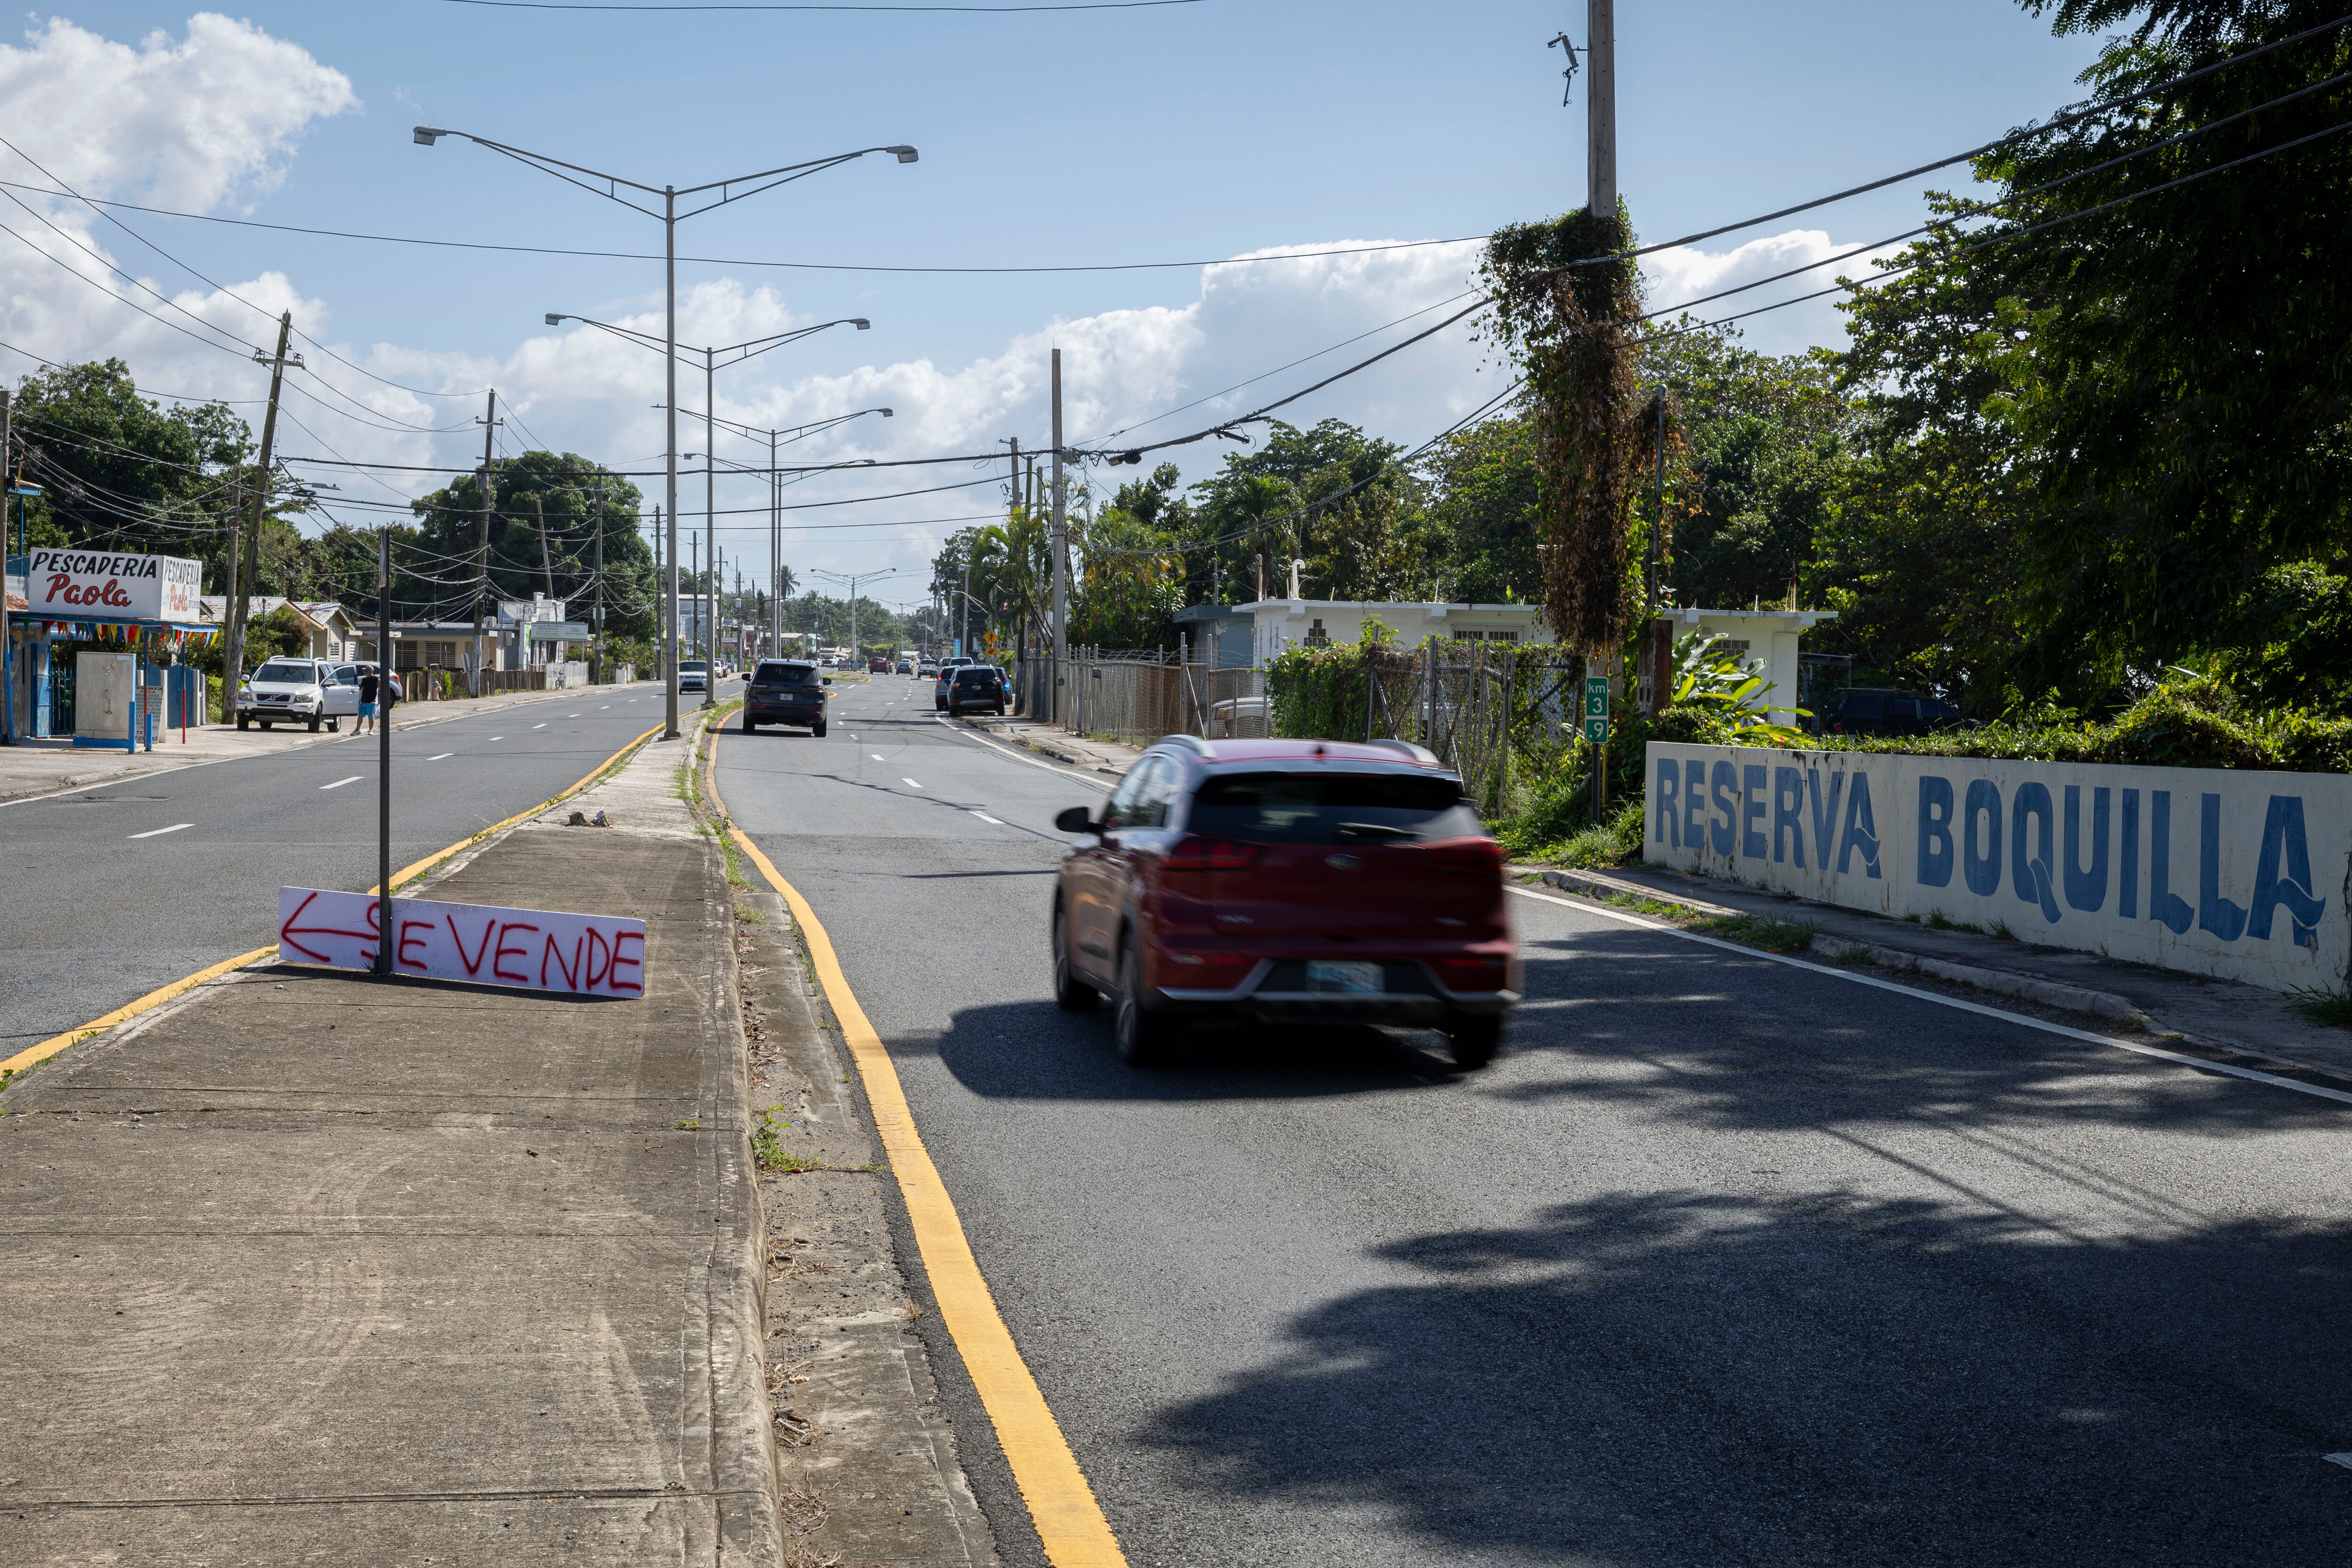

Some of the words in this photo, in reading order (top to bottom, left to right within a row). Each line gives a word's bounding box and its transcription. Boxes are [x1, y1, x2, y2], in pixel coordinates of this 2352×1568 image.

[32, 552, 157, 578] PESCADERÍA
[164, 559, 199, 586] PESCADERÍA
[46, 574, 132, 607] Paola
[169, 584, 188, 612] Paola
[1588, 683, 1605, 694] km
[1592, 698, 1603, 713] 3
[1655, 757, 1882, 879] RESERVA
[1917, 775, 2326, 951] BOQUILLA
[447, 914, 644, 990] VENDE
